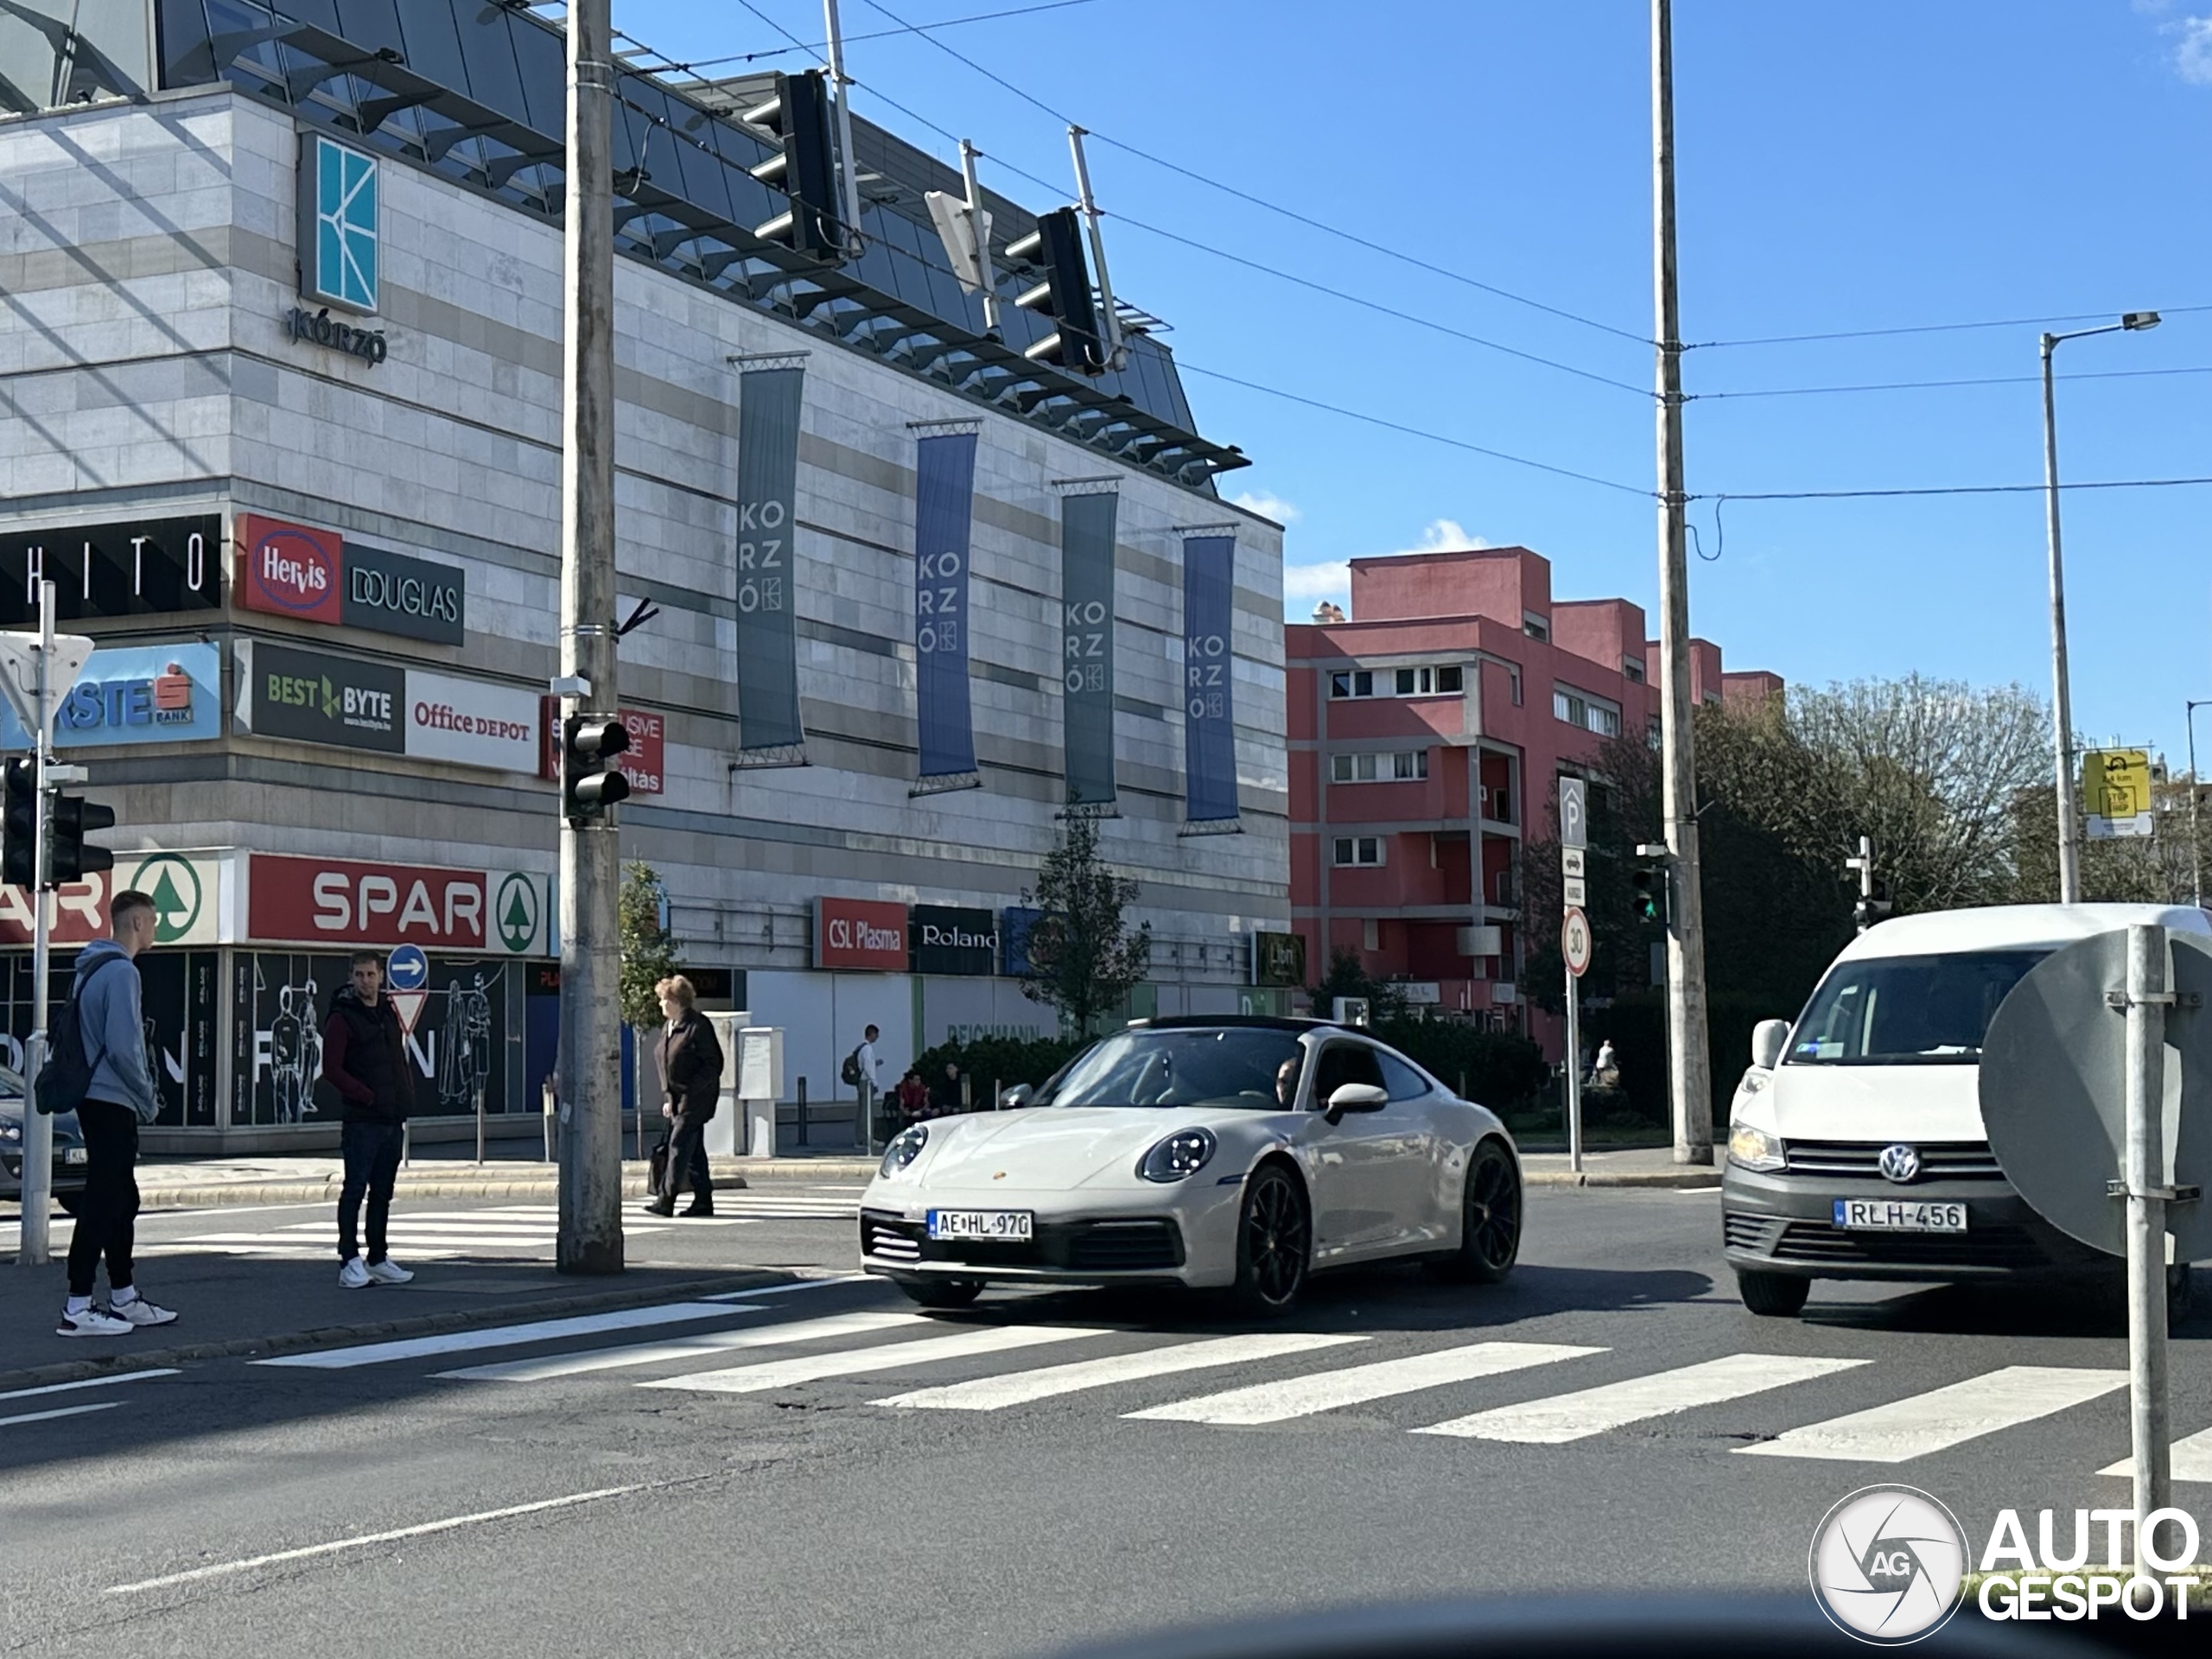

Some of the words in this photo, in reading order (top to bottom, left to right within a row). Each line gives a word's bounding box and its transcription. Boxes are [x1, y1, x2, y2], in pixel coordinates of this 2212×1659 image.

[739, 499, 785, 532] KO
[264, 544, 327, 594] Hervis
[739, 539, 782, 571] RZ
[918, 551, 960, 581] KO
[352, 566, 457, 622] DOUGLAS
[918, 587, 957, 616] RZ
[1065, 601, 1106, 626] KO
[1065, 633, 1104, 659] RZ
[1188, 635, 1224, 658] KO
[1188, 664, 1224, 688] RZ
[57, 678, 154, 729] STE
[267, 674, 318, 708] BEST
[344, 687, 391, 720] BYTE
[156, 709, 189, 722] BANK
[415, 702, 473, 734] Office
[475, 721, 531, 741] DEPOT
[1567, 800, 1579, 840] P
[313, 872, 483, 936] SPAR
[828, 918, 853, 950] CSL
[855, 921, 901, 951] Plasma
[922, 925, 1000, 950] Roland
[1570, 927, 1583, 954] 30
[1852, 1203, 1960, 1226] RLH-456
